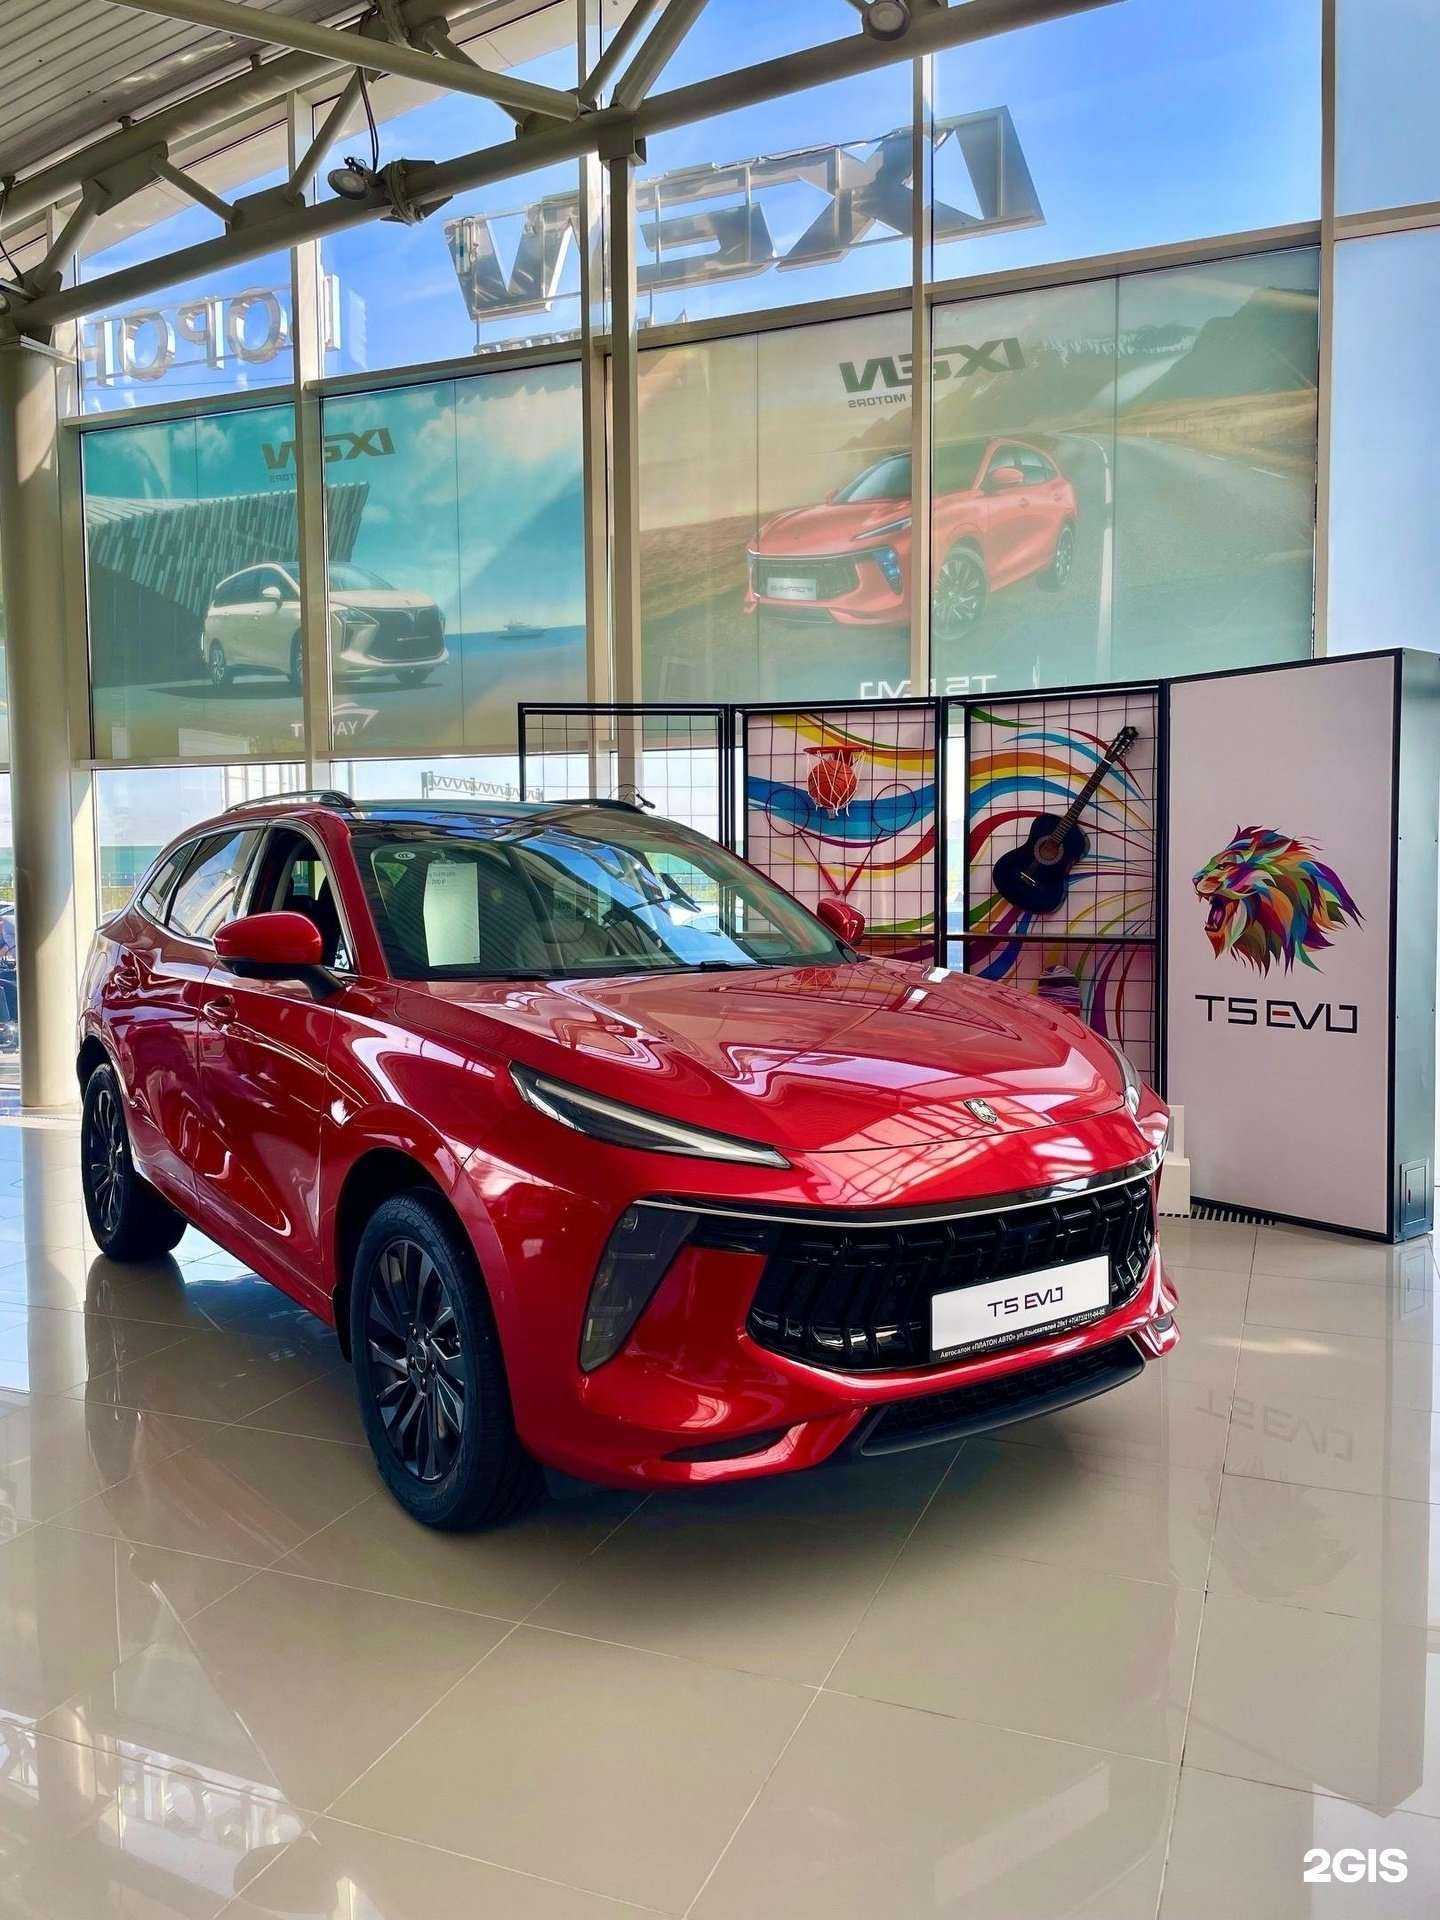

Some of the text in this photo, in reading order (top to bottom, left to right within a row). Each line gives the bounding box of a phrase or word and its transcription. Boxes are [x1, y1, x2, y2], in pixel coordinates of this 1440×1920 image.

[1195, 994, 1357, 1034] T5 EVO
[987, 1286, 1064, 1318] T5 EVO
[940, 1345, 971, 1358] Автосалон
